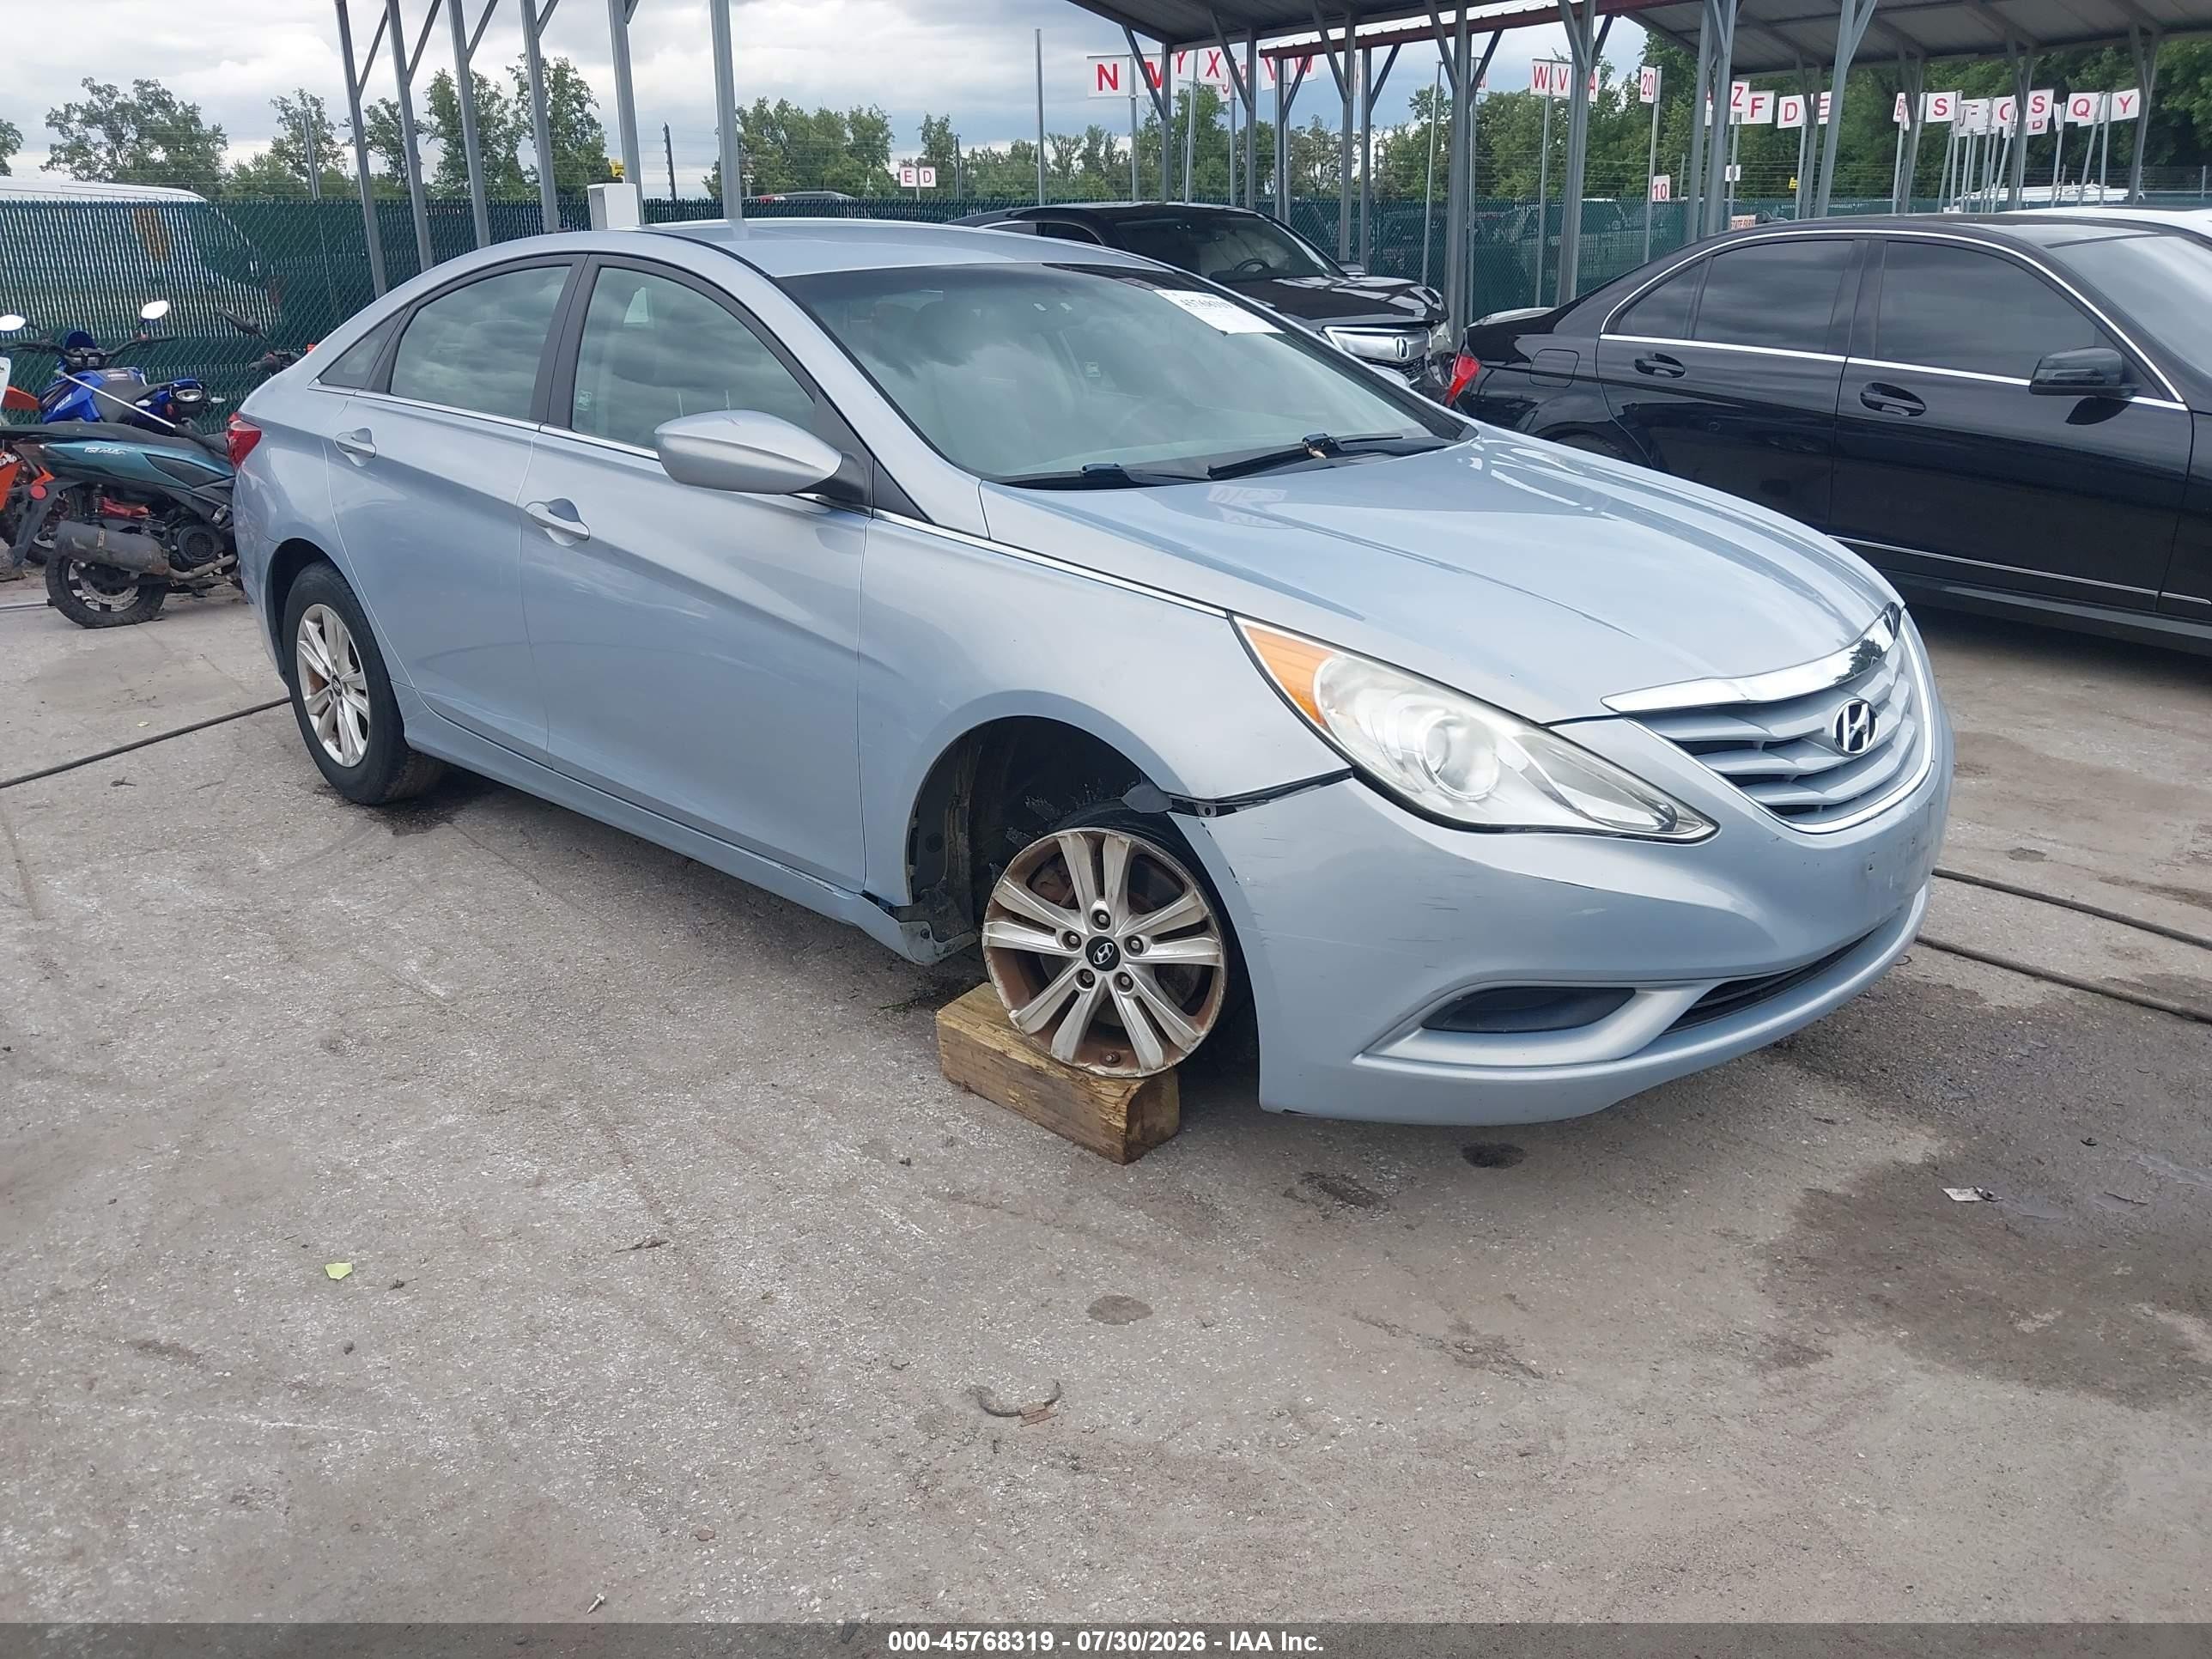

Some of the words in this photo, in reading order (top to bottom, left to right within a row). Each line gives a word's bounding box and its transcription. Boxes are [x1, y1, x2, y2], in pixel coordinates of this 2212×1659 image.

[1206, 50, 1221, 78] X
[1097, 63, 1118, 91] N
[1534, 65, 1548, 89] W
[1558, 68, 1568, 91] V
[1642, 73, 1654, 96] 20
[1732, 86, 1744, 107] Z
[2032, 95, 2045, 113] S
[2118, 94, 2134, 113] Y
[1750, 97, 1765, 118] F
[1784, 102, 1798, 122] D
[1933, 98, 1948, 116] S
[2072, 98, 2090, 118] Q
[904, 170, 913, 183] E
[923, 170, 932, 183] D
[1654, 183, 1668, 200] 10
